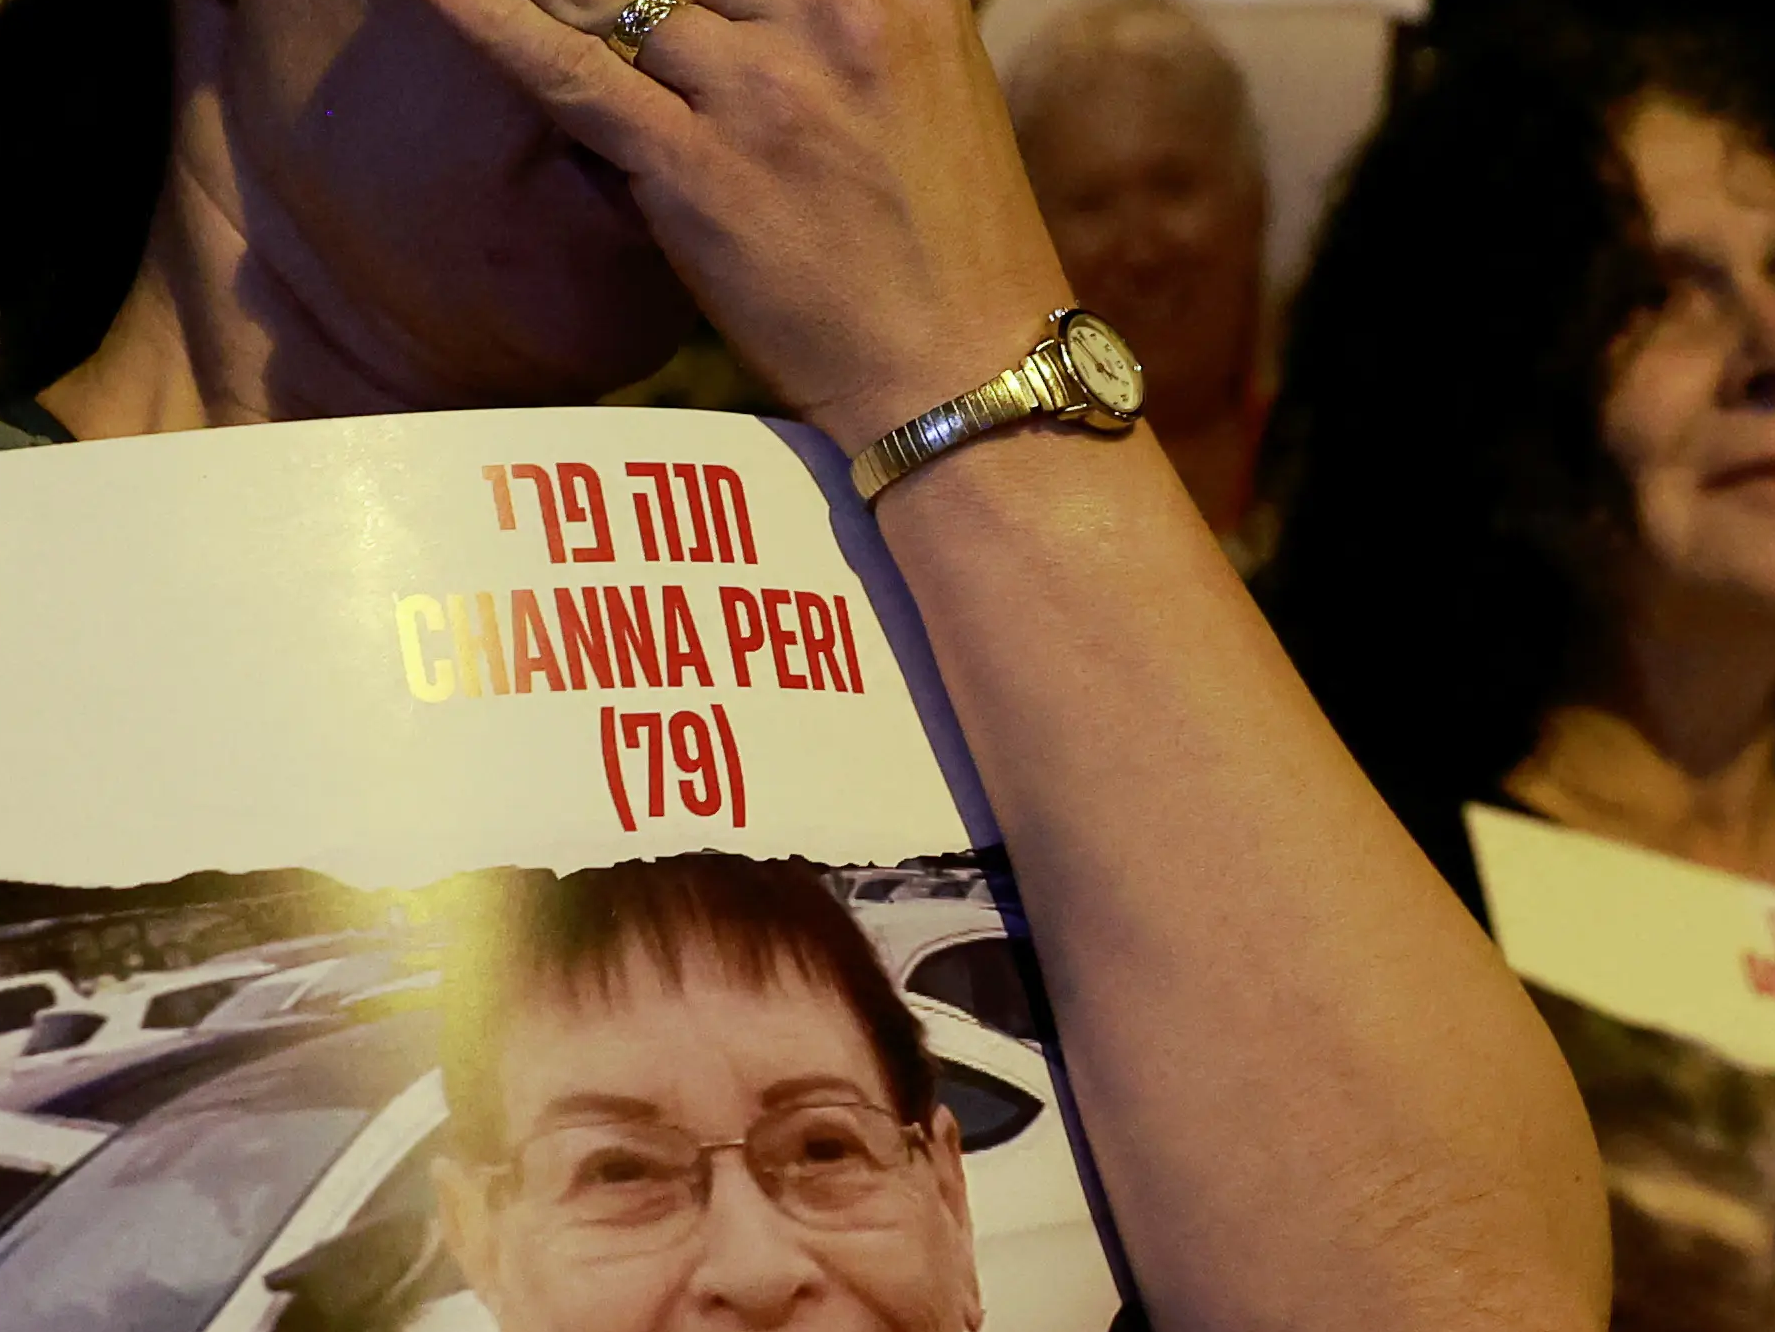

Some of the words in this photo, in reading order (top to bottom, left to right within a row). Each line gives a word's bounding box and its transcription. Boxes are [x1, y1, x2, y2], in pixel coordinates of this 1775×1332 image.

[482, 462, 616, 564] פרי
[625, 462, 758, 565] חנה
[394, 584, 715, 705] CHANNA
[718, 585, 865, 695] PERI
[600, 703, 747, 833] (79)
